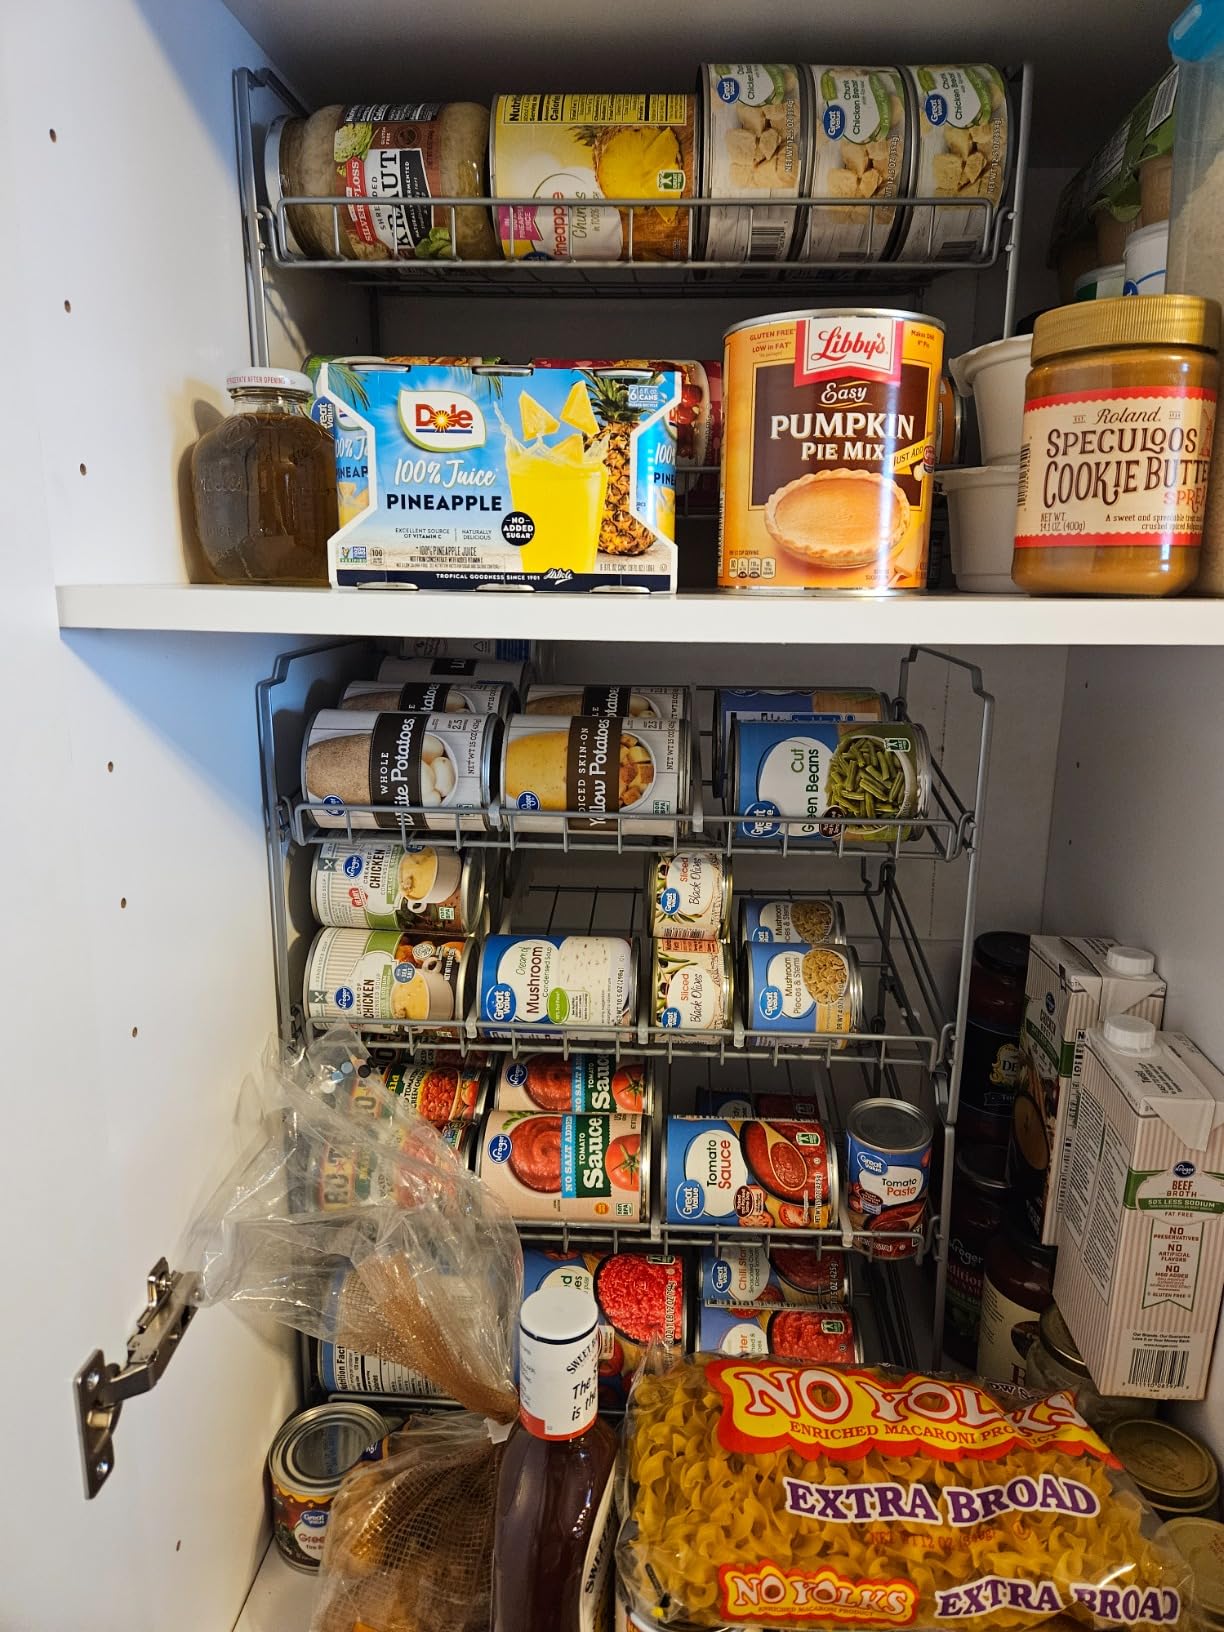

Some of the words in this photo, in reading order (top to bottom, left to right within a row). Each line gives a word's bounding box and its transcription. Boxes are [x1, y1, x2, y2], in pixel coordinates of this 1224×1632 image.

[722, 80, 731, 100] Great
[746, 77, 755, 100] Chicken
[843, 79, 851, 101] Chunk
[930, 99, 940, 122] Great
[938, 99, 946, 116] Value
[952, 89, 963, 120] Chicken
[828, 110, 837, 136] Great
[836, 110, 844, 130] Value
[852, 102, 861, 136] Chicken
[786, 142, 793, 156] WT
[785, 157, 793, 173] NET
[889, 156, 896, 169] OZ
[988, 164, 995, 178] WT
[986, 178, 994, 194] NET
[371, 176, 387, 231] SHREDED
[570, 191, 588, 239] Chuns
[552, 191, 568, 257] Pineappe
[750, 330, 776, 342] GLUTEN
[810, 326, 888, 361] Libby's
[752, 344, 768, 353] LOW
[628, 386, 638, 400] 6
[820, 382, 868, 404] Easy
[415, 403, 473, 430] Dole
[770, 412, 914, 440] PUMPKIN
[800, 442, 838, 461] PIE
[842, 441, 886, 461] MIX
[1046, 426, 1198, 458] SPECULOOS
[893, 451, 910, 466] JUST
[910, 446, 924, 459] ADD
[394, 458, 442, 486] 100%
[1042, 459, 1142, 508] COOKIE
[386, 493, 502, 512] PINEAPPLE
[502, 524, 534, 532] ADDED
[1041, 512, 1053, 522] NET
[1063, 520, 1086, 532] (400g)
[1106, 514, 1111, 522] A
[1113, 514, 1136, 522] sweet
[1138, 514, 1151, 522] and
[452, 719, 463, 730] 2.5
[391, 718, 415, 782] Potatoes
[578, 727, 589, 774] SKIN-ON
[589, 718, 610, 776] Potatoes
[666, 759, 674, 770] NET
[790, 748, 804, 773] Cut
[806, 748, 820, 793] Beans
[380, 752, 390, 795] WHOLE
[394, 784, 415, 827] Wite
[578, 778, 586, 812] DICED
[750, 808, 766, 835] Gret
[802, 797, 818, 832] Geen
[370, 848, 386, 889] CHICKEN
[680, 856, 688, 882] Sliced
[690, 856, 702, 880] Olives
[664, 892, 673, 912] Great
[688, 882, 700, 905] Black
[542, 960, 552, 998] Condensed
[784, 956, 792, 997] Mushroom
[793, 956, 801, 978] Stems
[526, 946, 543, 1014] Mushroom
[692, 974, 702, 997] Olives
[363, 979, 374, 1019] CHICKEN
[494, 990, 504, 1021] Great
[502, 991, 511, 1014] Value
[690, 998, 700, 1023] Black
[765, 992, 775, 1016] Great
[510, 1065, 524, 1086] Kroger
[576, 1098, 582, 1112] NO
[564, 1115, 572, 1144] ADDED
[492, 1136, 508, 1162] Kroger
[564, 1146, 572, 1174] SALT
[578, 1132, 586, 1165] TOMATO
[583, 1118, 604, 1189] Sauce
[706, 1139, 718, 1187] Tomato
[718, 1139, 732, 1190] Sauce
[860, 1155, 883, 1170] Great
[864, 1162, 883, 1172] Value
[565, 1176, 573, 1192] NO
[882, 1176, 918, 1188] Tomato
[886, 1186, 917, 1198] Paste
[1166, 1190, 1198, 1198] BROTH
[1172, 1180, 1194, 1191] BEEF
[682, 1186, 694, 1214] Great
[691, 1186, 699, 1210] Value
[1184, 1200, 1215, 1208] SODIUM
[1153, 1234, 1200, 1242] PRESERVATIVES
[1169, 1226, 1184, 1235] NO
[1168, 1244, 1182, 1252] NO
[715, 1264, 724, 1289] Great
[738, 1268, 746, 1291] Chili
[566, 1346, 592, 1374] SWEET
[572, 1378, 590, 1401] The
[736, 1370, 853, 1424] NO
[572, 1406, 580, 1421] is
[790, 1420, 878, 1440] ENRICHED
[884, 1424, 976, 1445] MACARONI
[981, 1426, 1058, 1445] PROUCT
[788, 1480, 938, 1522] EXTRA
[948, 1476, 1097, 1525] BROAD
[734, 1574, 787, 1607] NO
[792, 1578, 908, 1617] YOLKS
[937, 1578, 1064, 1618] EXTRA
[1073, 1587, 1179, 1622] BROAD
